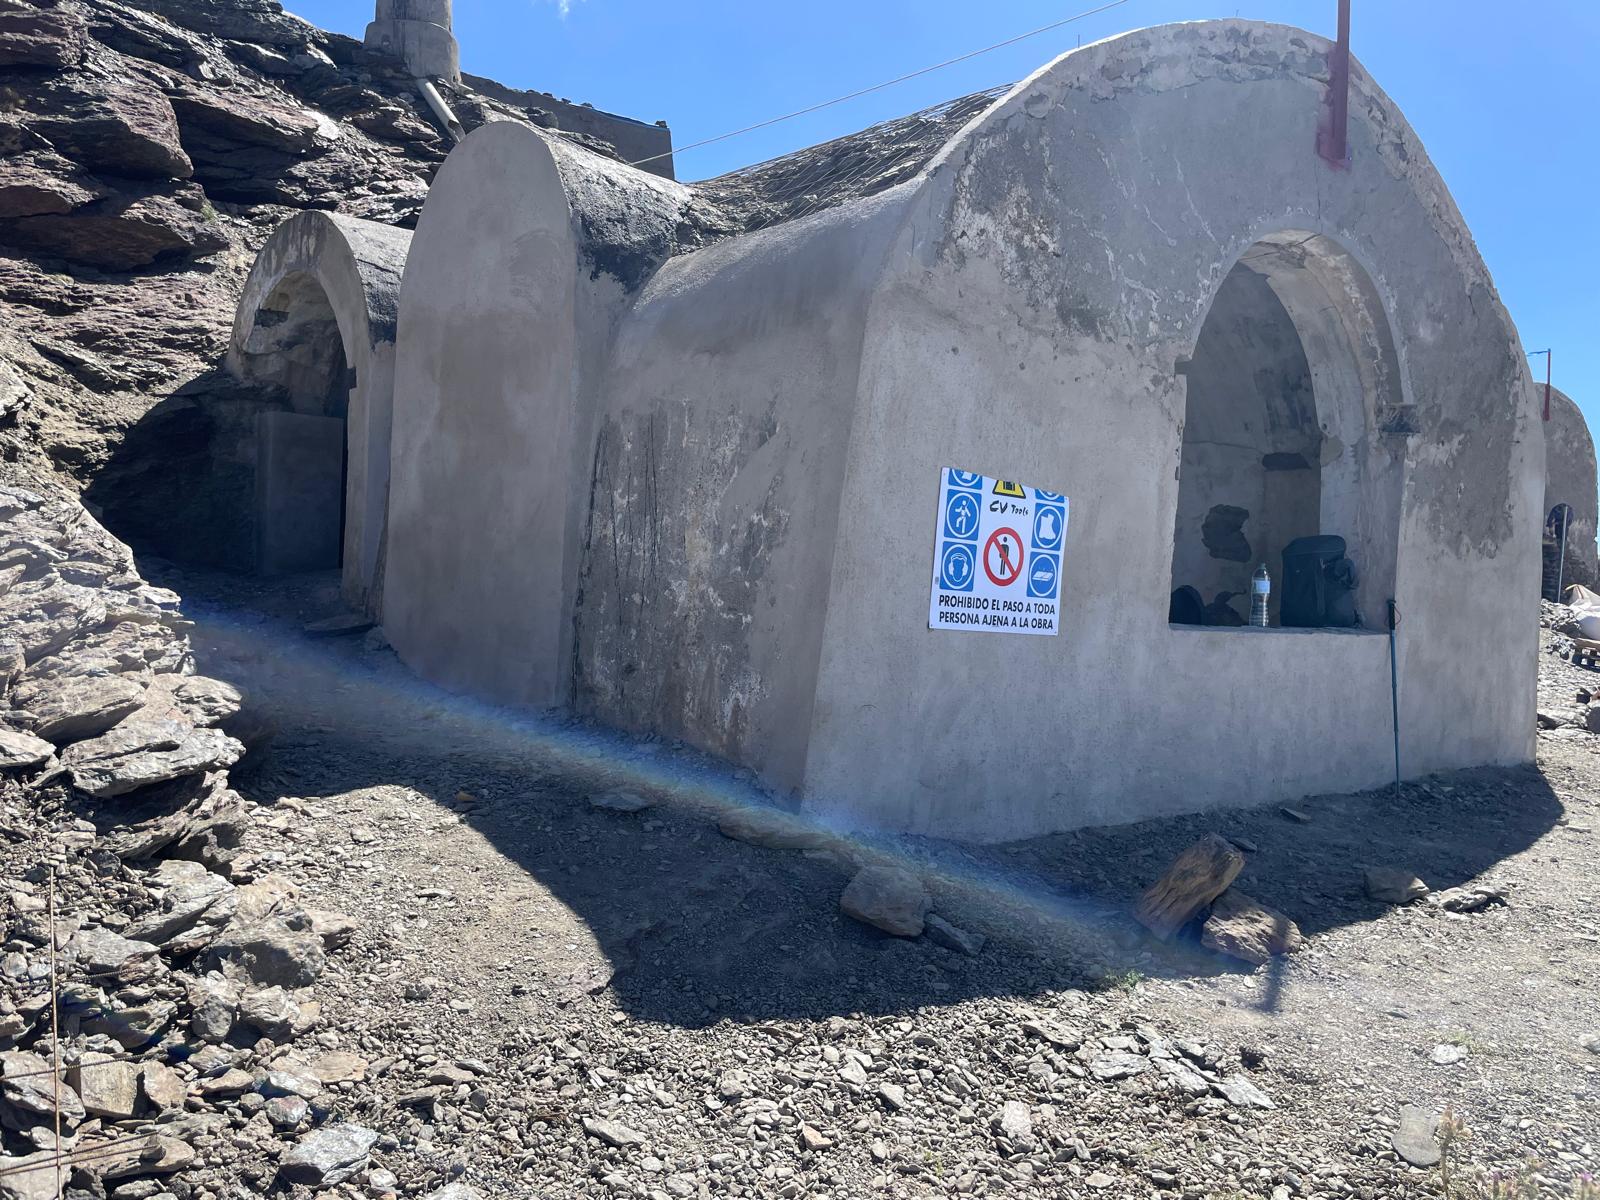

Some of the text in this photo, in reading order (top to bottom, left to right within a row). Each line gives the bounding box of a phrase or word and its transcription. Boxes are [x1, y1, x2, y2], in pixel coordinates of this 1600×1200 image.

[989, 500, 1029, 516] CV Tools
[939, 594, 1056, 615] PROHIBIDO EL PASO A TODA
[939, 611, 1054, 629] PERSONA AJENA A LA OBRA
